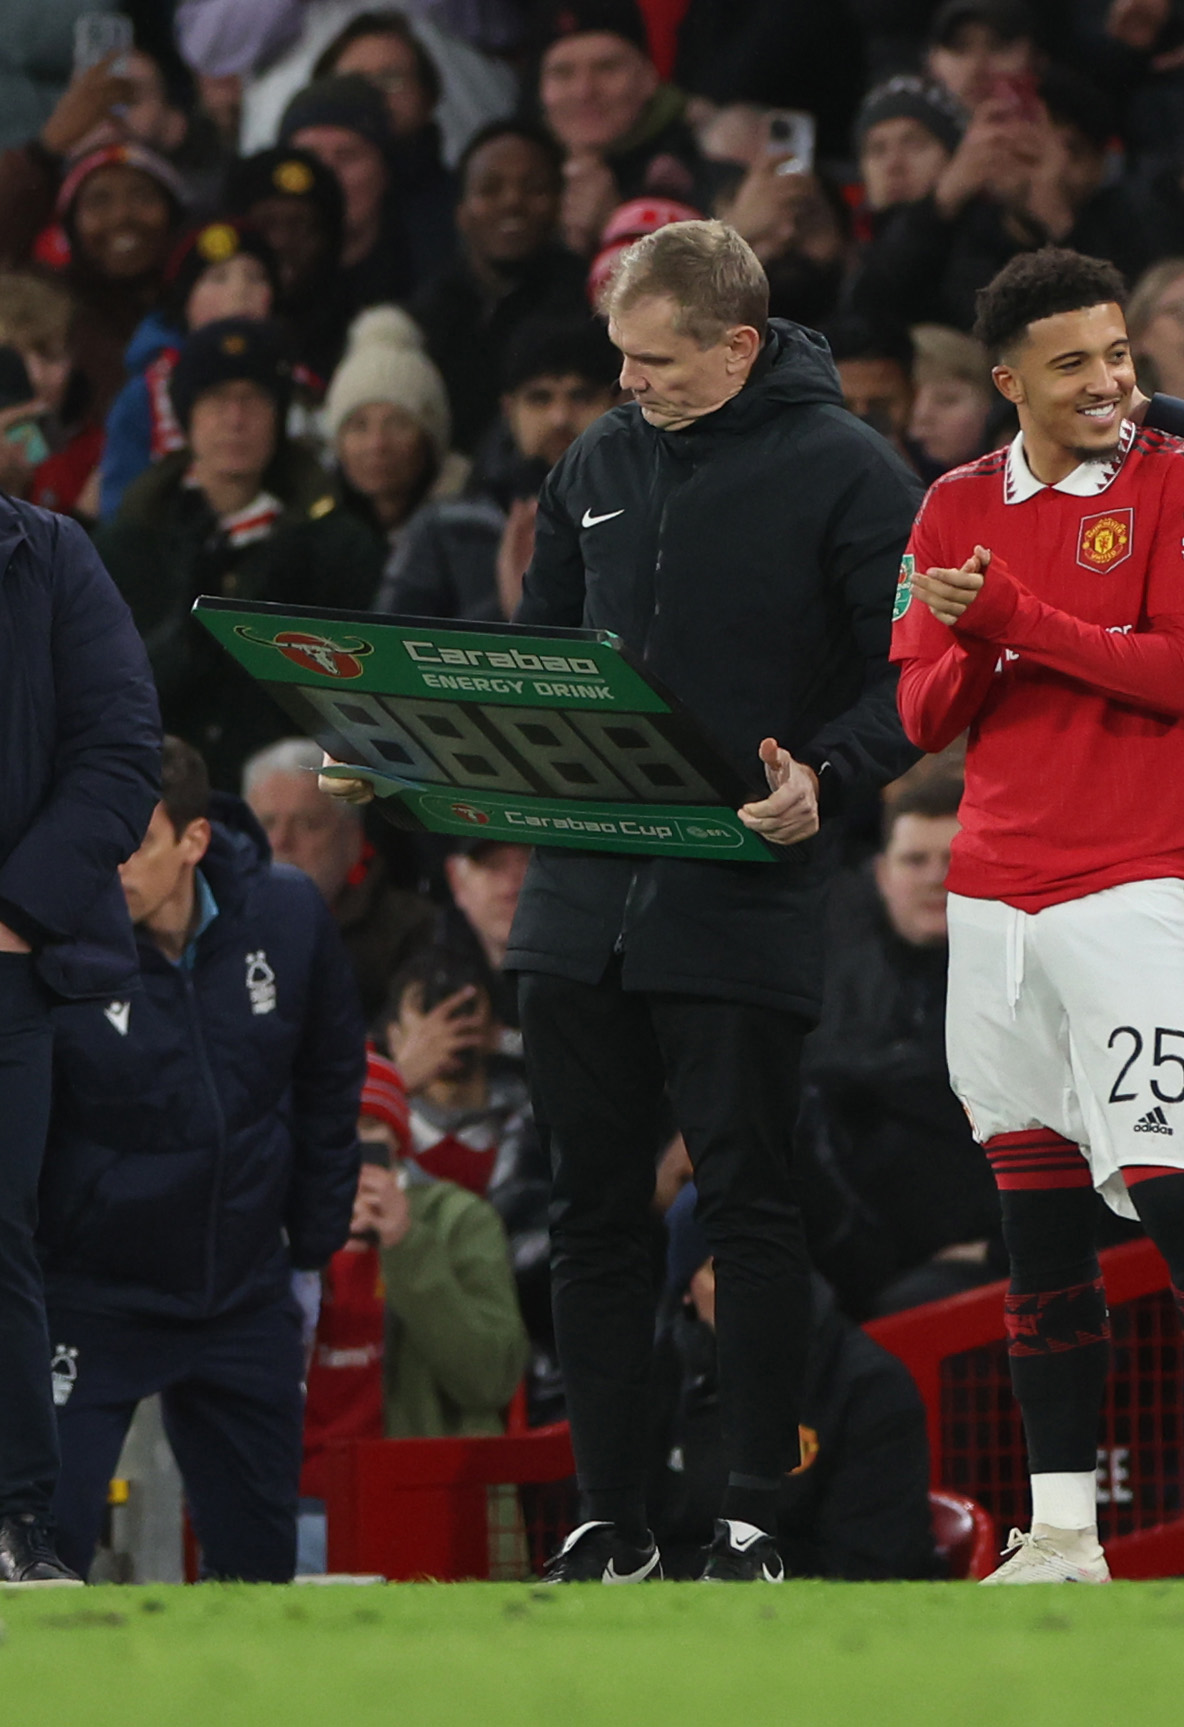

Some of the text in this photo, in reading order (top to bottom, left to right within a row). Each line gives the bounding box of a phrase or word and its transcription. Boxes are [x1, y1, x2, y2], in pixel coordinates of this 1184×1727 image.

[402, 640, 600, 674] Carabao
[421, 673, 615, 700] ENERGY DRINK
[504, 811, 673, 839] Carabao Cup
[1133, 1123, 1174, 1136] adidas
